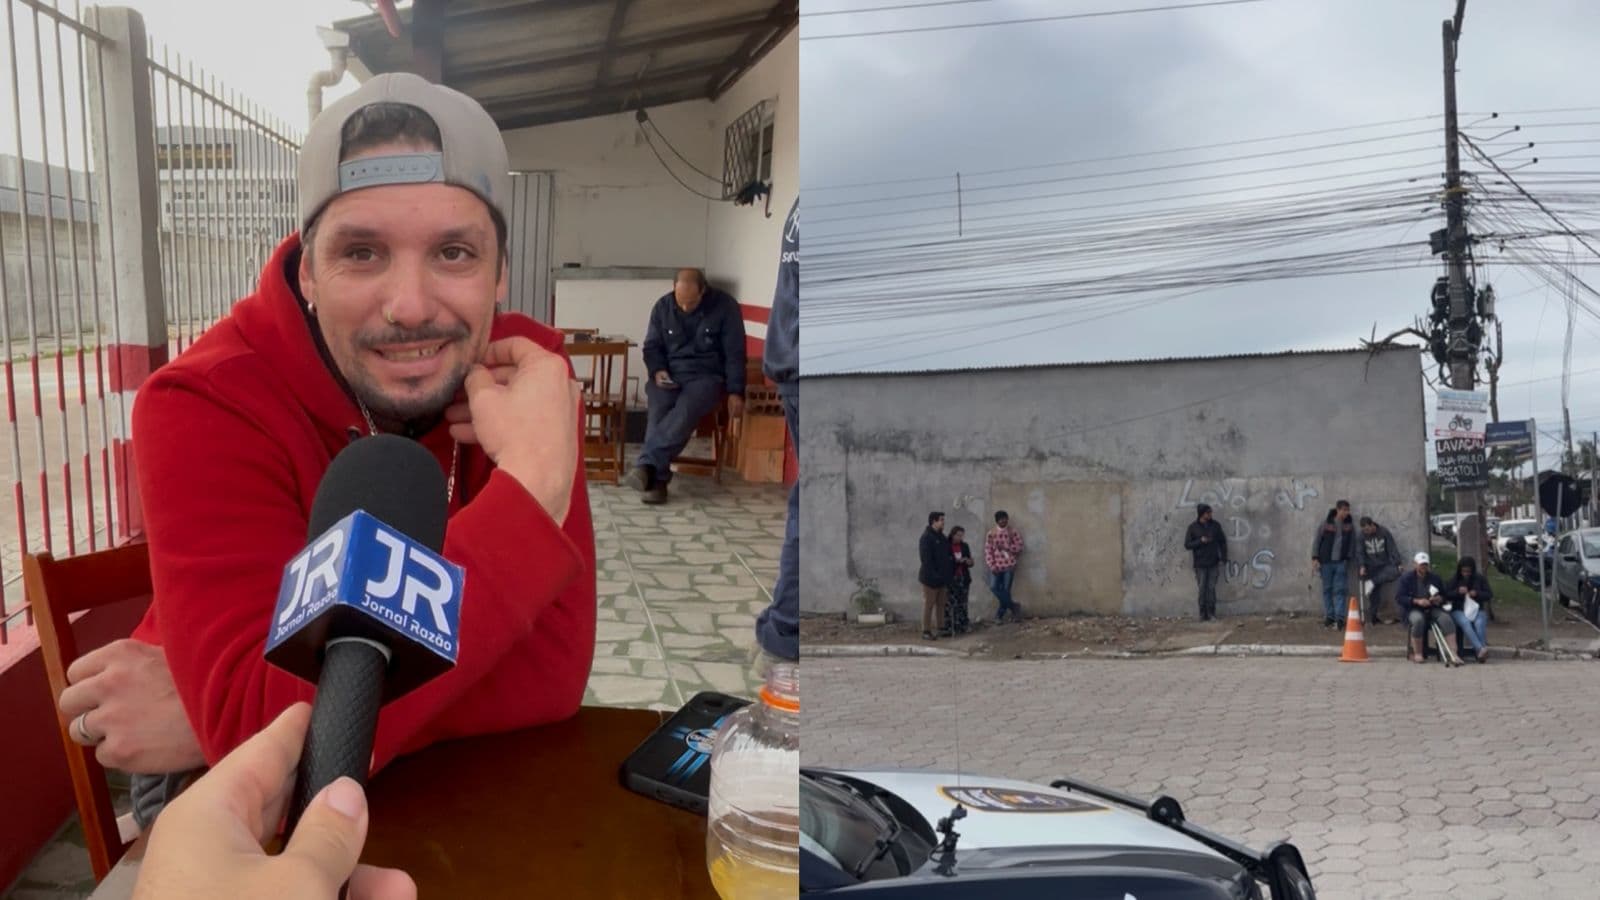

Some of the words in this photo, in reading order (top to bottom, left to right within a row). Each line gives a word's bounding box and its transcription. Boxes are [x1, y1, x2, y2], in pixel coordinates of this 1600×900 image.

[279, 528, 344, 626] JR
[365, 528, 452, 635] JR
[274, 608, 306, 641] Jornal
[361, 594, 408, 628] Jornal
[409, 619, 453, 651] Razão
